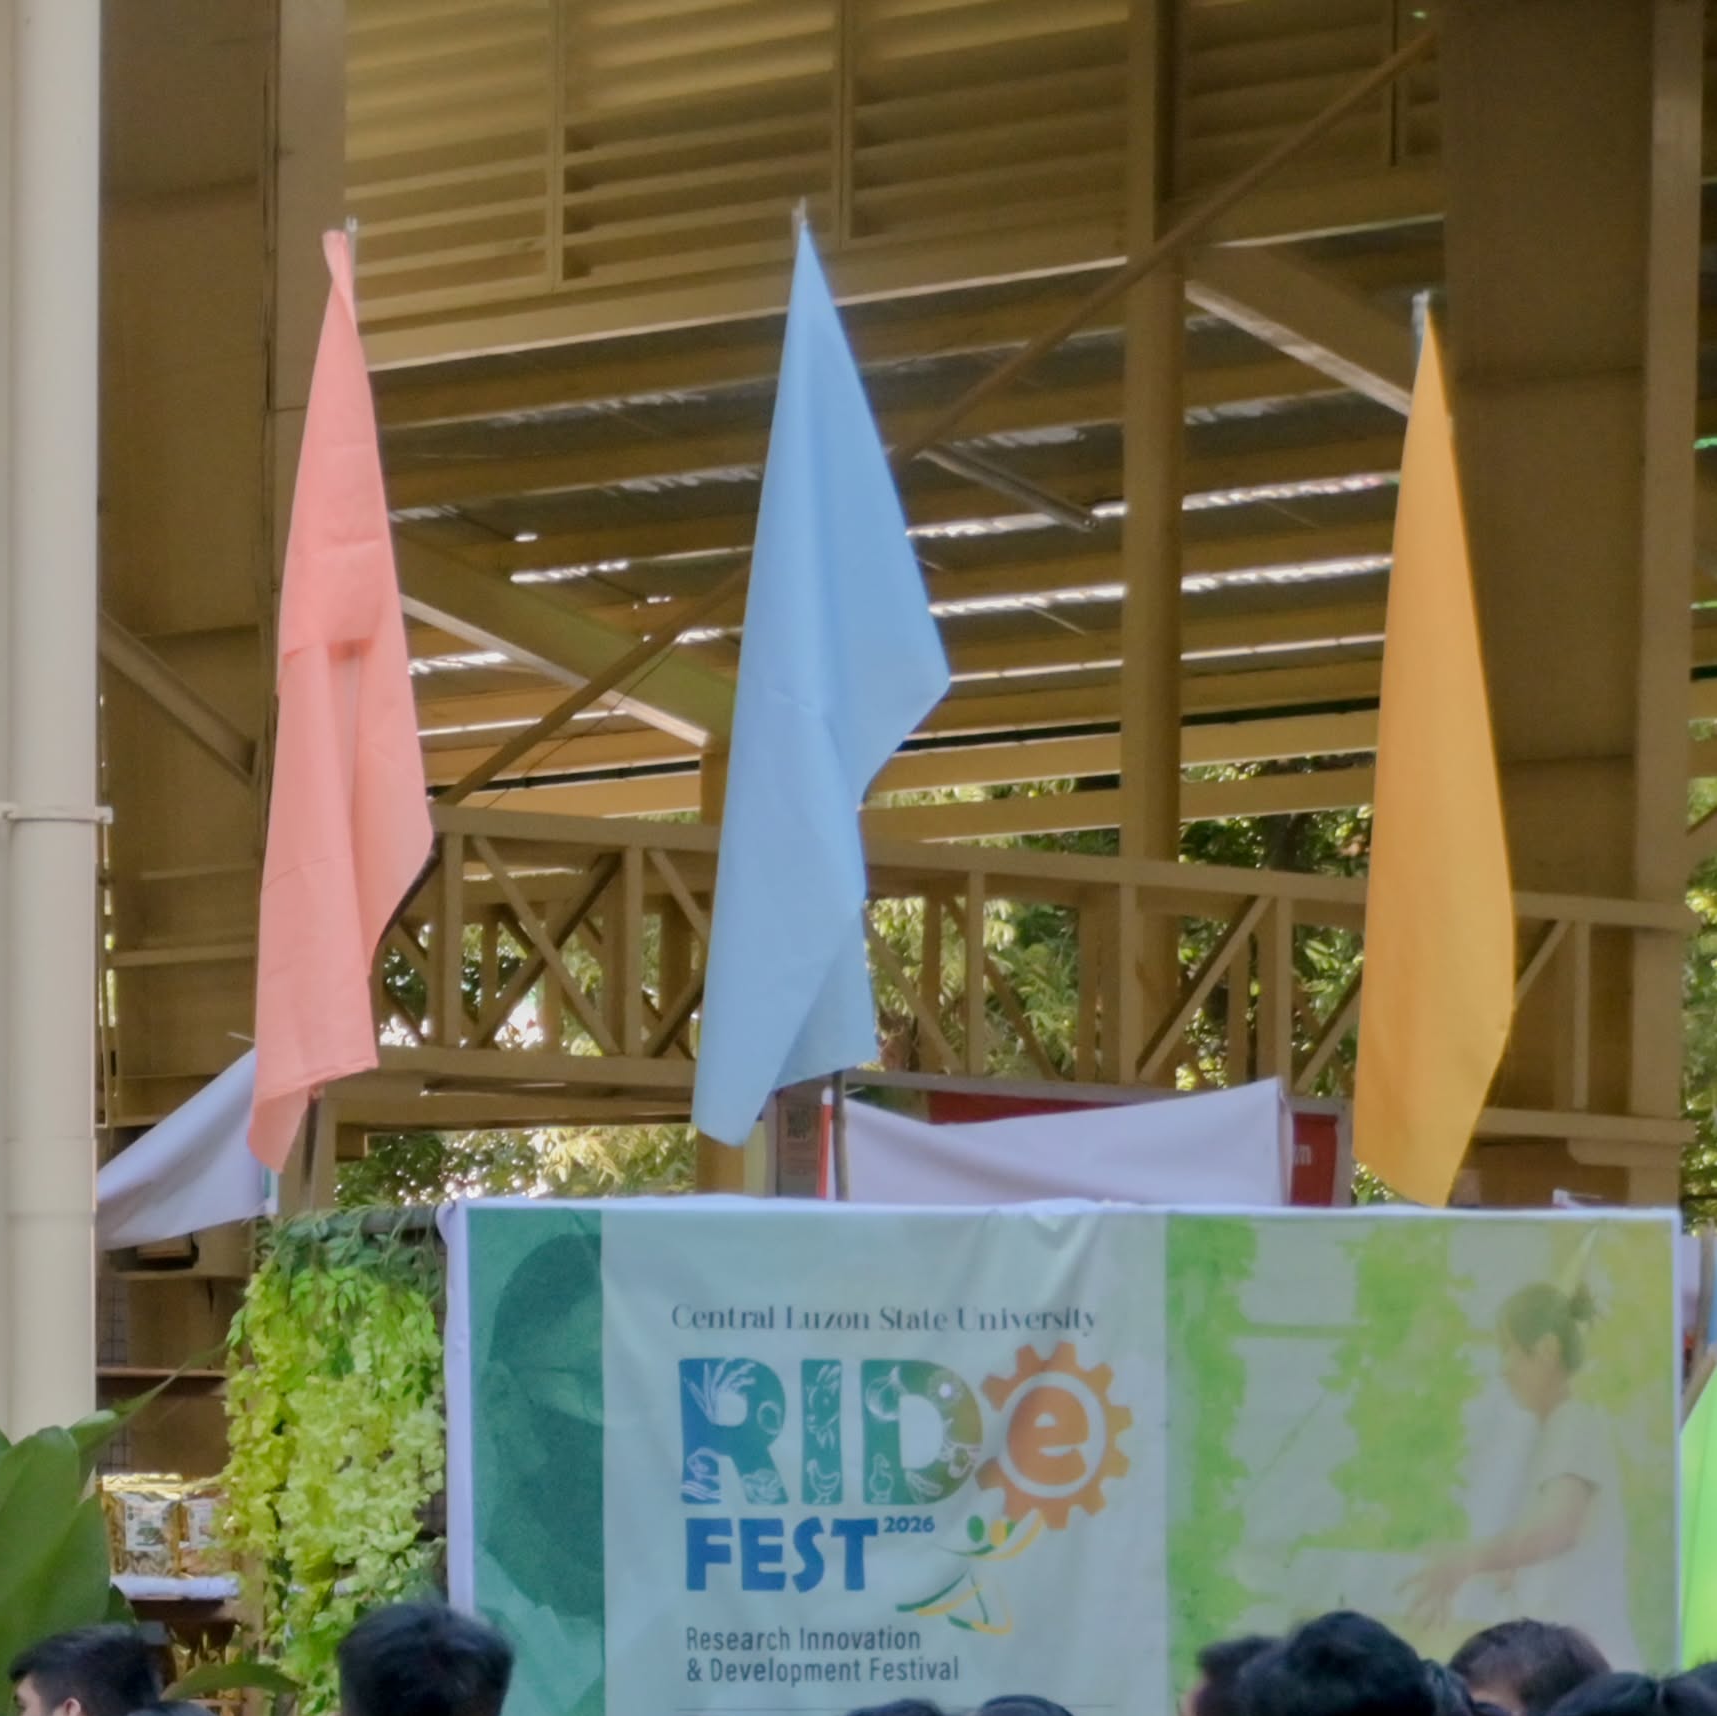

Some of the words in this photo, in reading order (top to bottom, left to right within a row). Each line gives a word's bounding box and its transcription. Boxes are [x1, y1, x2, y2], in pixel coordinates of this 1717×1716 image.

[671, 1303, 775, 1330] Central
[786, 1305, 870, 1331] Luzon
[879, 1305, 949, 1331] State
[957, 1304, 1097, 1337] University
[685, 1516, 879, 1593] FEST
[883, 1516, 936, 1534] 2026
[686, 1626, 791, 1651] Research
[799, 1626, 921, 1651] Innovation
[687, 1657, 703, 1683] &
[711, 1657, 861, 1688] Development
[869, 1655, 959, 1682] Festival
